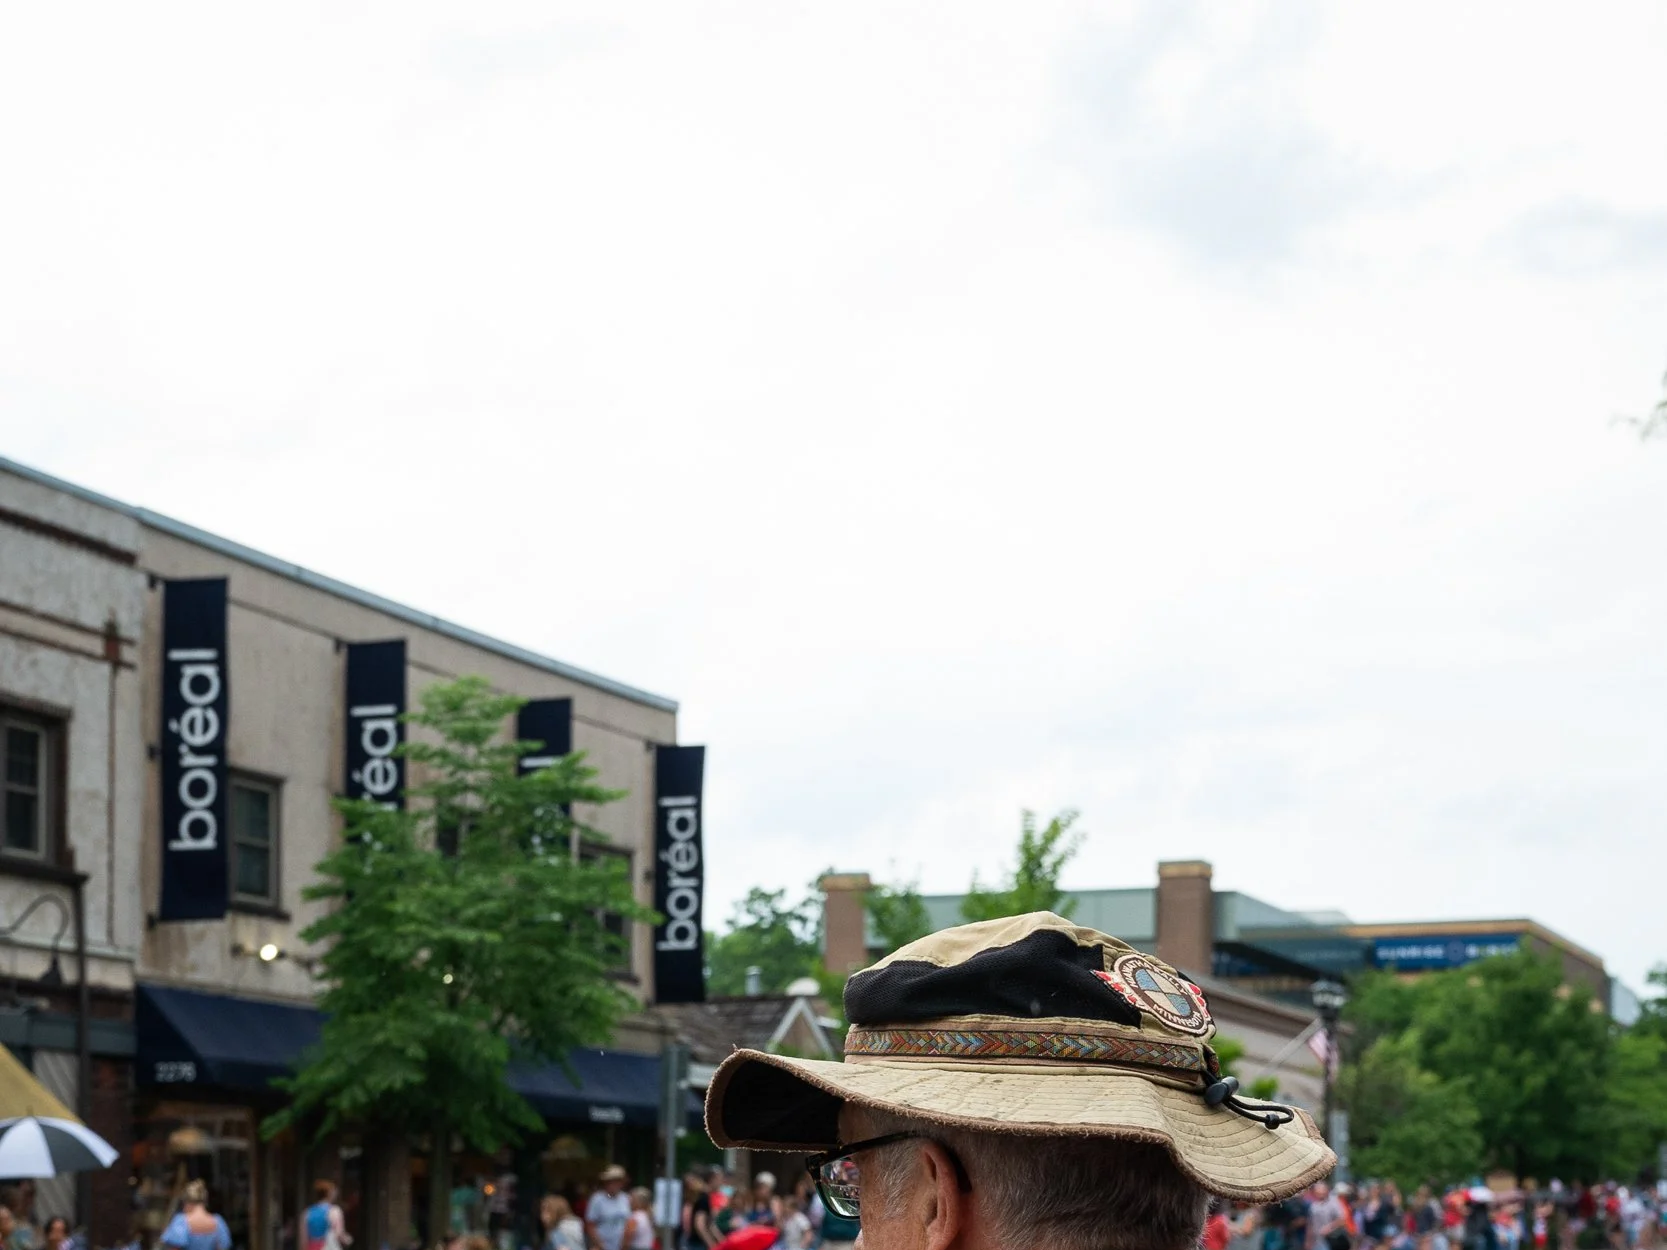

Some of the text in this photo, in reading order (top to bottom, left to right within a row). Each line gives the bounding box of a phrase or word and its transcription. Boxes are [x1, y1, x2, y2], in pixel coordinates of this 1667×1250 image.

[167, 648, 220, 850] boréal
[657, 796, 699, 951] boréal
[1152, 1003, 1204, 1028] MINNESOTA
